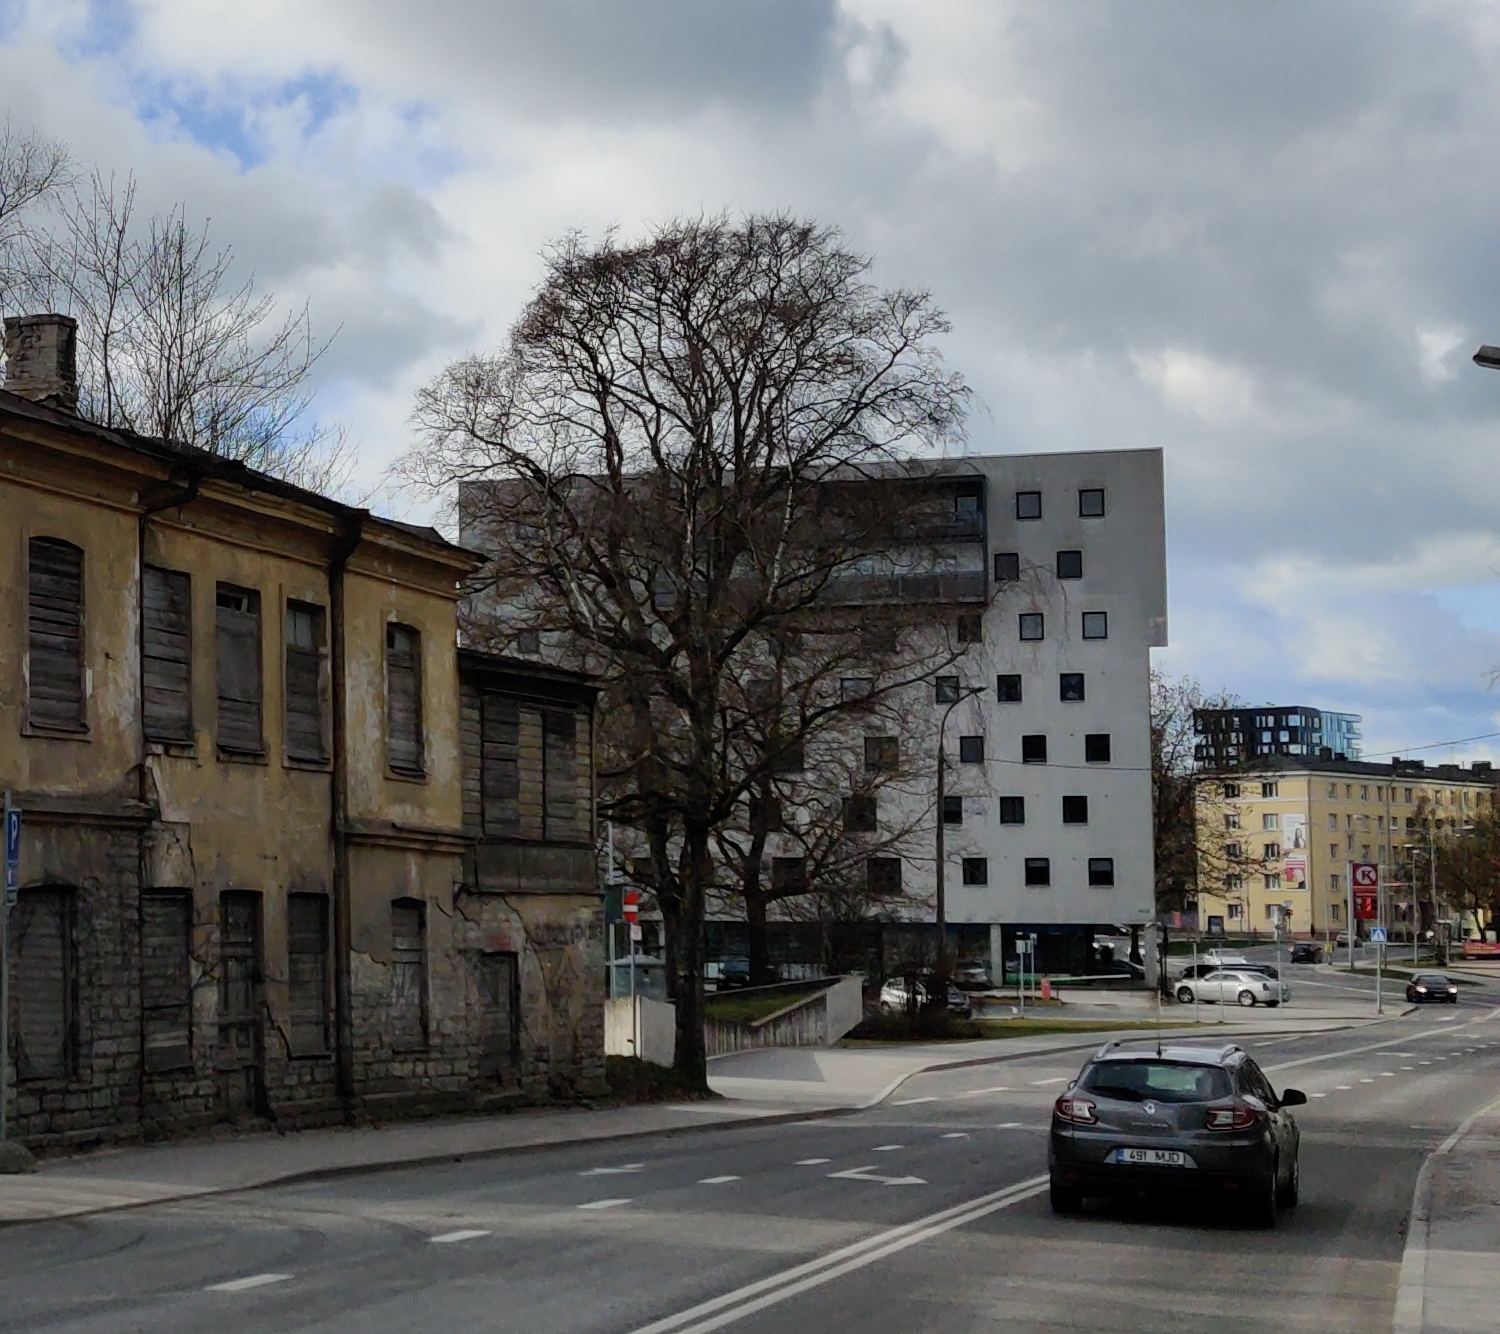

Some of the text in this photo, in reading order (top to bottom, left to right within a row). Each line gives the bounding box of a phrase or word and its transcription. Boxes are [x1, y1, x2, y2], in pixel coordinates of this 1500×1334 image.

[11, 812, 18, 851] P
[1129, 1150, 1180, 1164] 491 MJD
